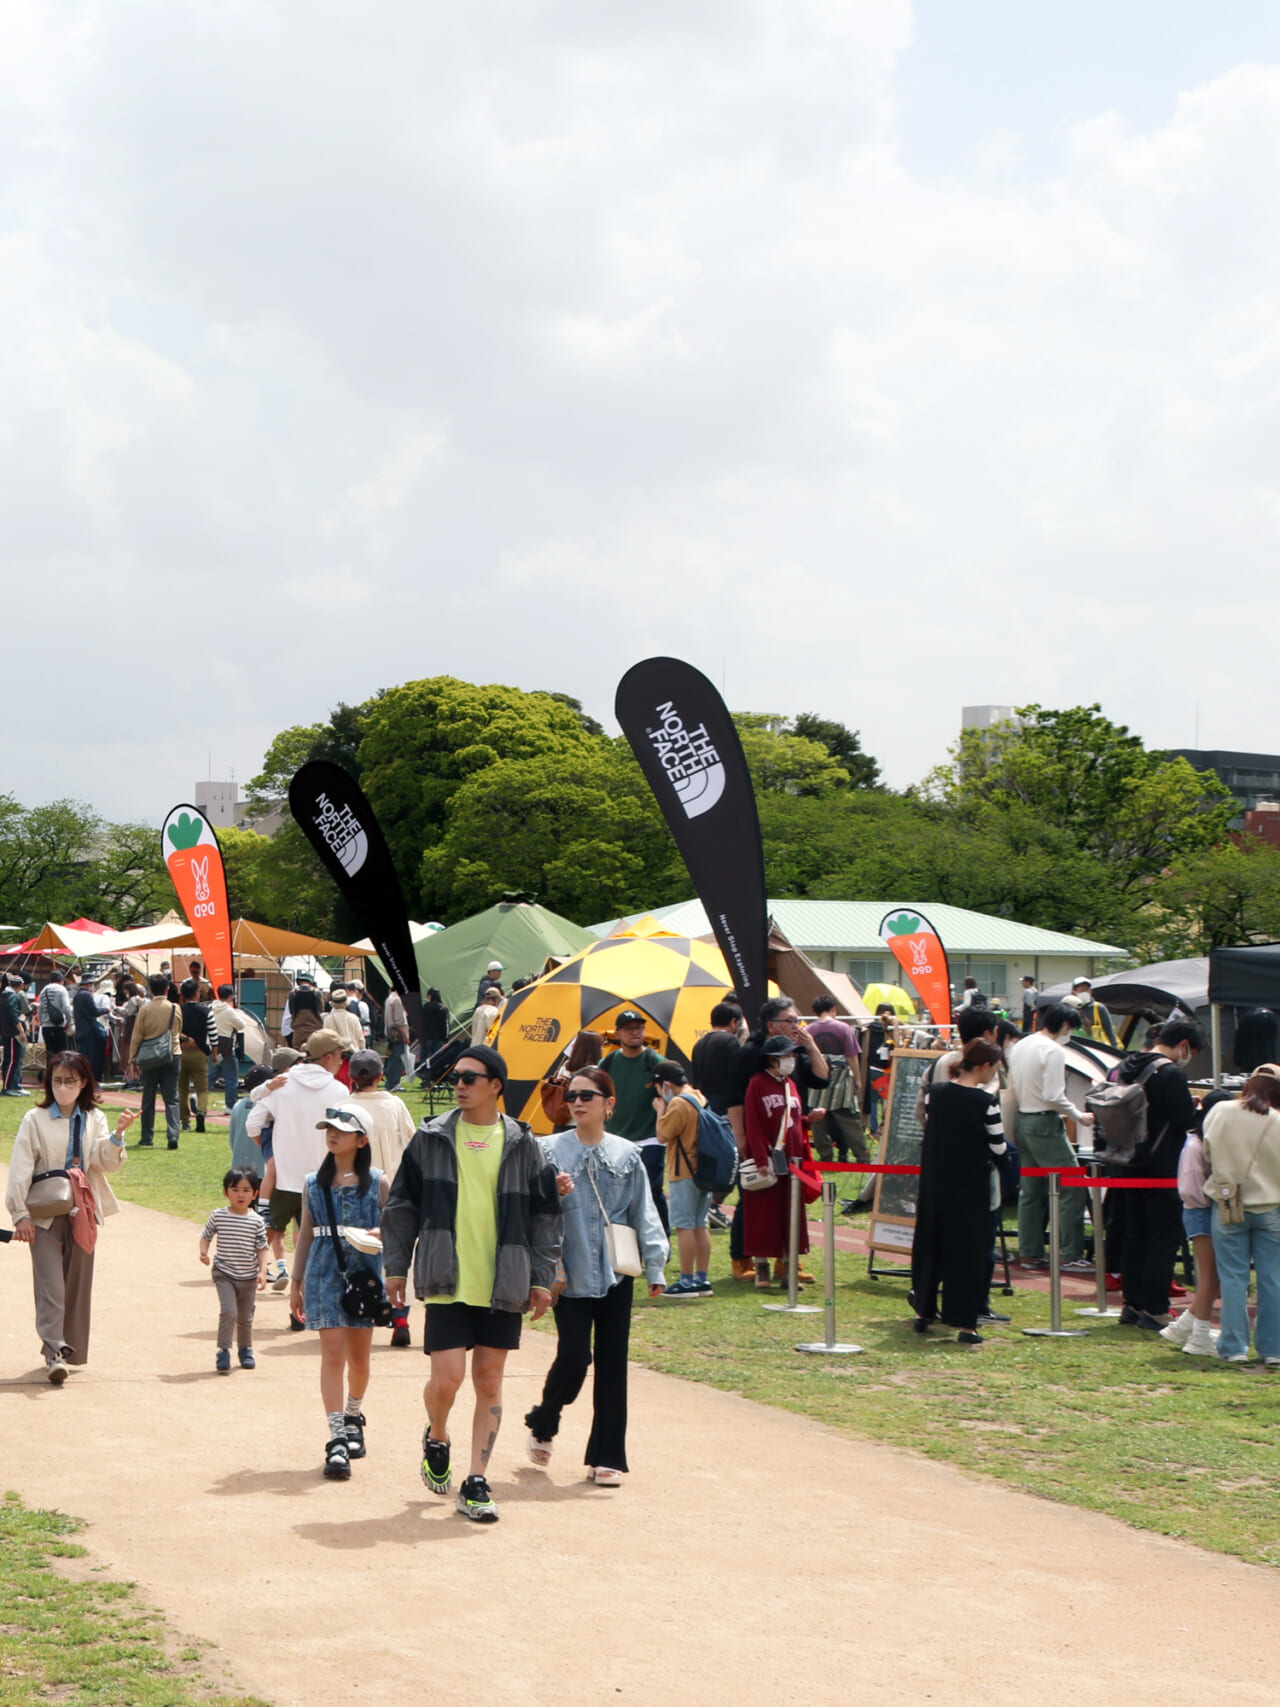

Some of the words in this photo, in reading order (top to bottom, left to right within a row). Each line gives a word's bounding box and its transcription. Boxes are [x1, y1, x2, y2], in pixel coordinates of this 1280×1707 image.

[649, 728, 688, 782] FACE
[656, 701, 704, 775] NORTH
[689, 723, 720, 767] THE
[314, 815, 344, 854] FACE
[315, 792, 353, 844] NORTH
[340, 803, 362, 836] THE
[720, 914, 731, 934] Never
[727, 935, 738, 952] Stop
[911, 965, 932, 975] DOD
[519, 1024, 548, 1033] NORTH
[523, 1032, 546, 1042] FACE
[536, 1017, 553, 1026] THE
